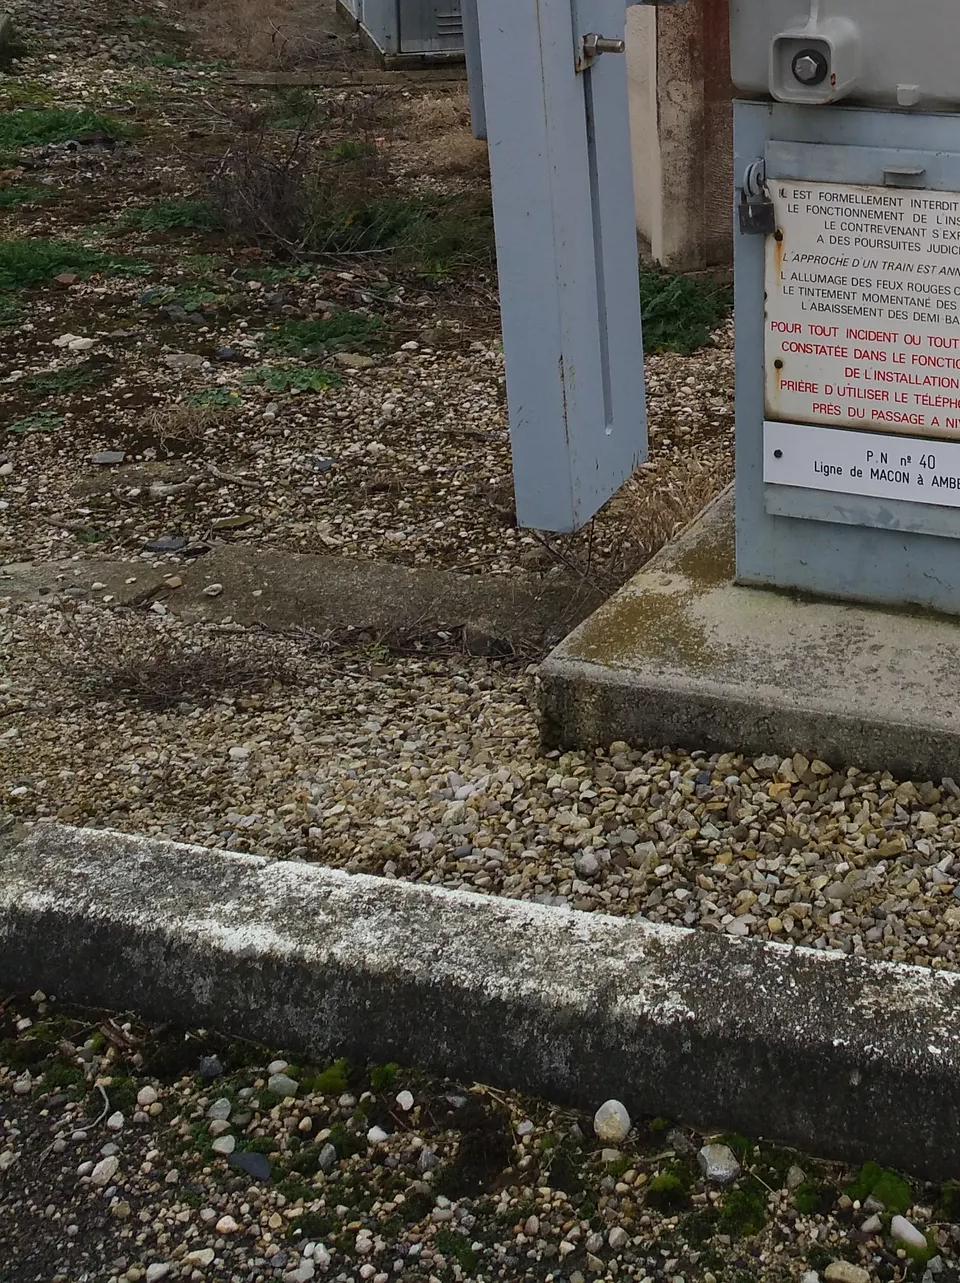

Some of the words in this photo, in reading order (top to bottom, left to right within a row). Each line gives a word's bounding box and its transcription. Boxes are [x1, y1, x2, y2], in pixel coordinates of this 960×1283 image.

[793, 189, 812, 200] EST
[819, 191, 903, 208] FORMELLEMENT
[910, 199, 959, 211] INTERDIT
[788, 204, 799, 213] LE
[806, 205, 905, 221] FONCTIONNEMENT
[913, 213, 927, 224] DE
[824, 220, 836, 230] LE
[840, 222, 927, 237] CONTREVENANT
[816, 234, 824, 244] A
[829, 235, 851, 246] DES
[854, 237, 921, 252] POURSUITES
[782, 251, 849, 267] L'APPROCHE
[882, 261, 914, 272] TRAIN
[916, 264, 937, 274] EST
[851, 277, 872, 288] DES
[876, 279, 904, 291] FEUX
[907, 282, 951, 296] ROUGES
[783, 286, 794, 295] LE
[798, 286, 857, 301] TINTEMENT
[862, 293, 931, 308] MOMENTANÉ
[936, 299, 957, 311] DES
[888, 309, 908, 320] DES
[771, 321, 801, 334] POUR
[808, 324, 839, 337] TOUT
[846, 328, 899, 343] INCIDENT
[904, 334, 921, 345] OU
[781, 341, 848, 358] CONSTATÉE
[854, 348, 887, 362] DANS
[892, 352, 905, 364] LE
[845, 367, 860, 379] DE
[780, 379, 819, 393] PRIÈRE
[894, 392, 908, 403] LE
[812, 402, 841, 416] PRÈS
[848, 406, 865, 418] DU
[871, 409, 924, 425] PASSAGE
[931, 416, 940, 427] A
[919, 454, 936, 469] 40
[814, 460, 842, 477] Ligne
[850, 466, 863, 478] de
[870, 467, 910, 484] MACON
[917, 474, 924, 486] à
